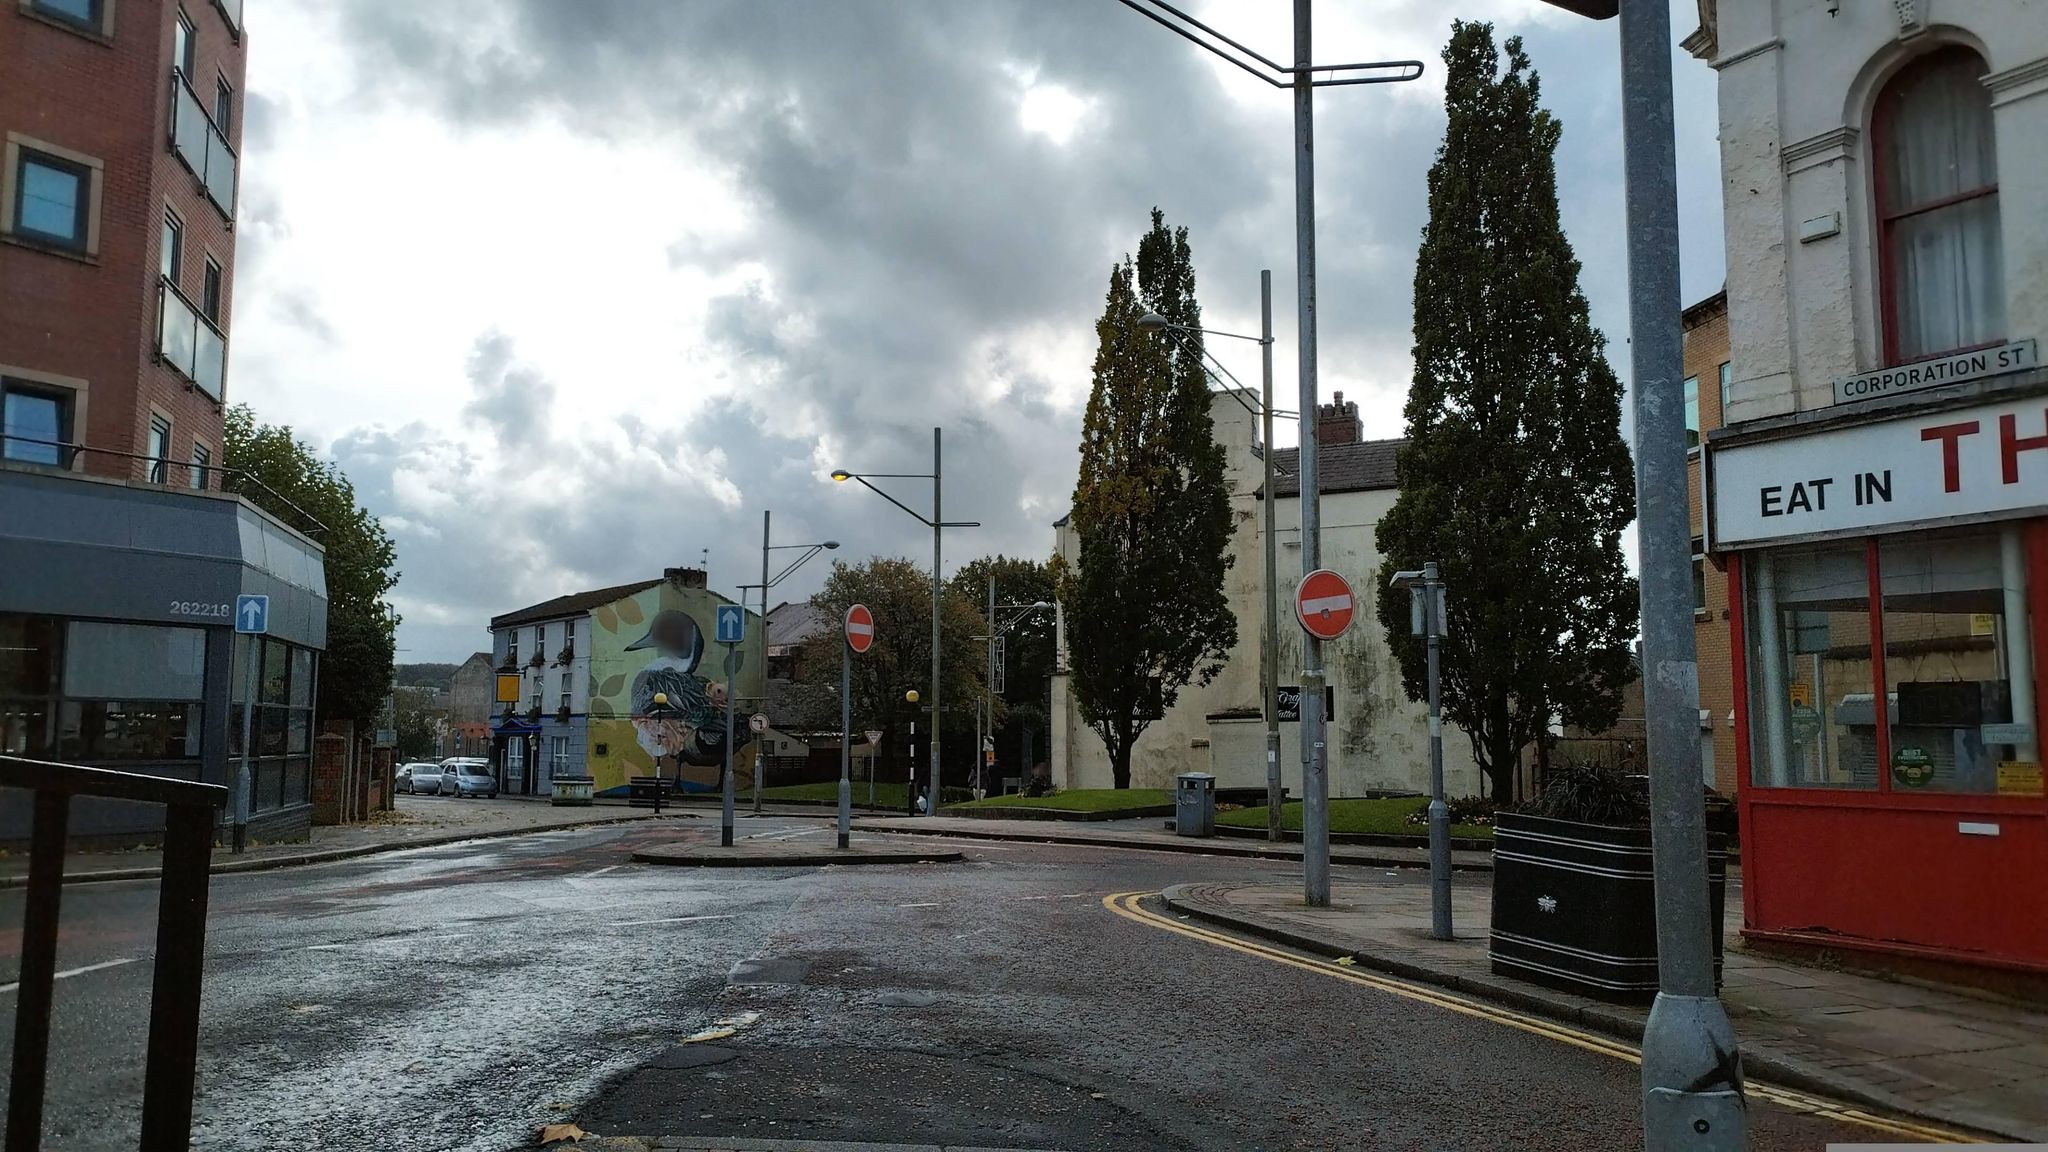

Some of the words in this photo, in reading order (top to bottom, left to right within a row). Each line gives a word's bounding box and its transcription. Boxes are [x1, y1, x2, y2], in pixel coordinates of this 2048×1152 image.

[1844, 355, 1986, 397] CORPORATION
[1998, 347, 2024, 368] ST
[1760, 478, 1833, 518] EAT
[1854, 470, 1892, 506] IN
[169, 600, 230, 617] 262218
